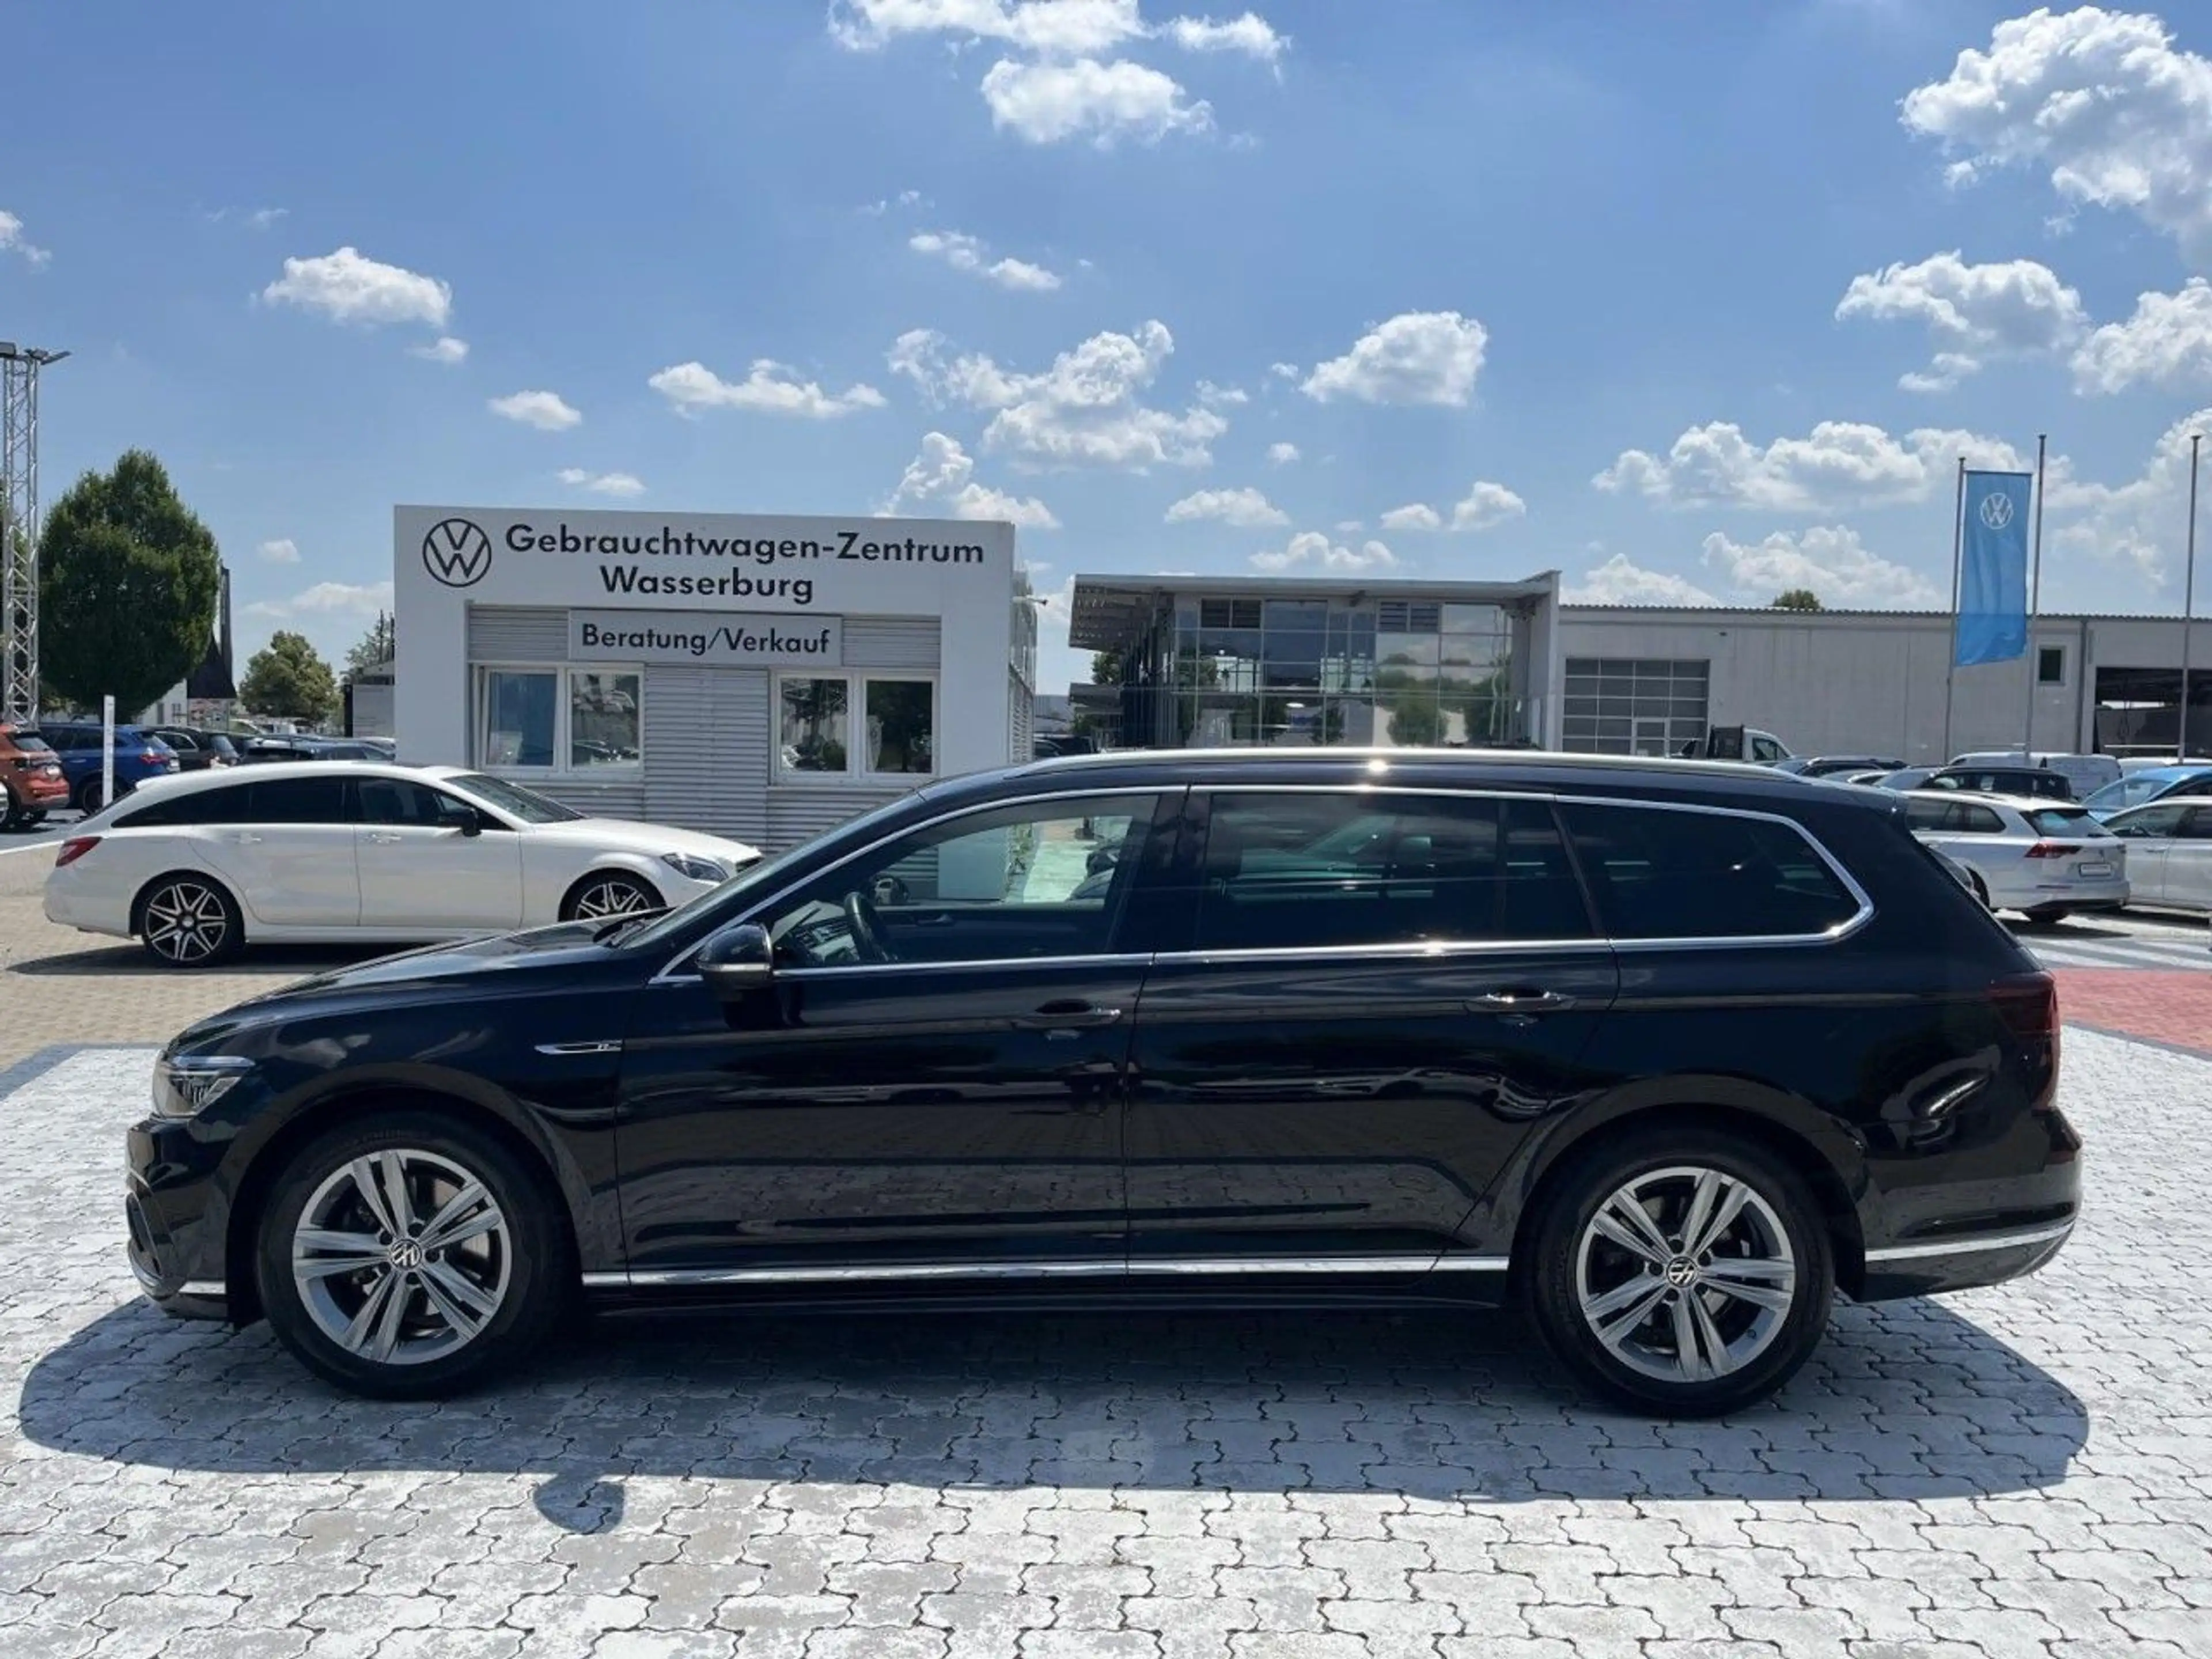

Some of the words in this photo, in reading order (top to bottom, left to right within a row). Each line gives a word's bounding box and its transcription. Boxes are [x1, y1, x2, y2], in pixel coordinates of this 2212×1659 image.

[422, 518, 493, 589] VW
[505, 523, 984, 566] Gebrauchtwagen-Zentrum
[599, 565, 813, 605] Wasserburg
[581, 622, 831, 657] Beratung/Verkauf
